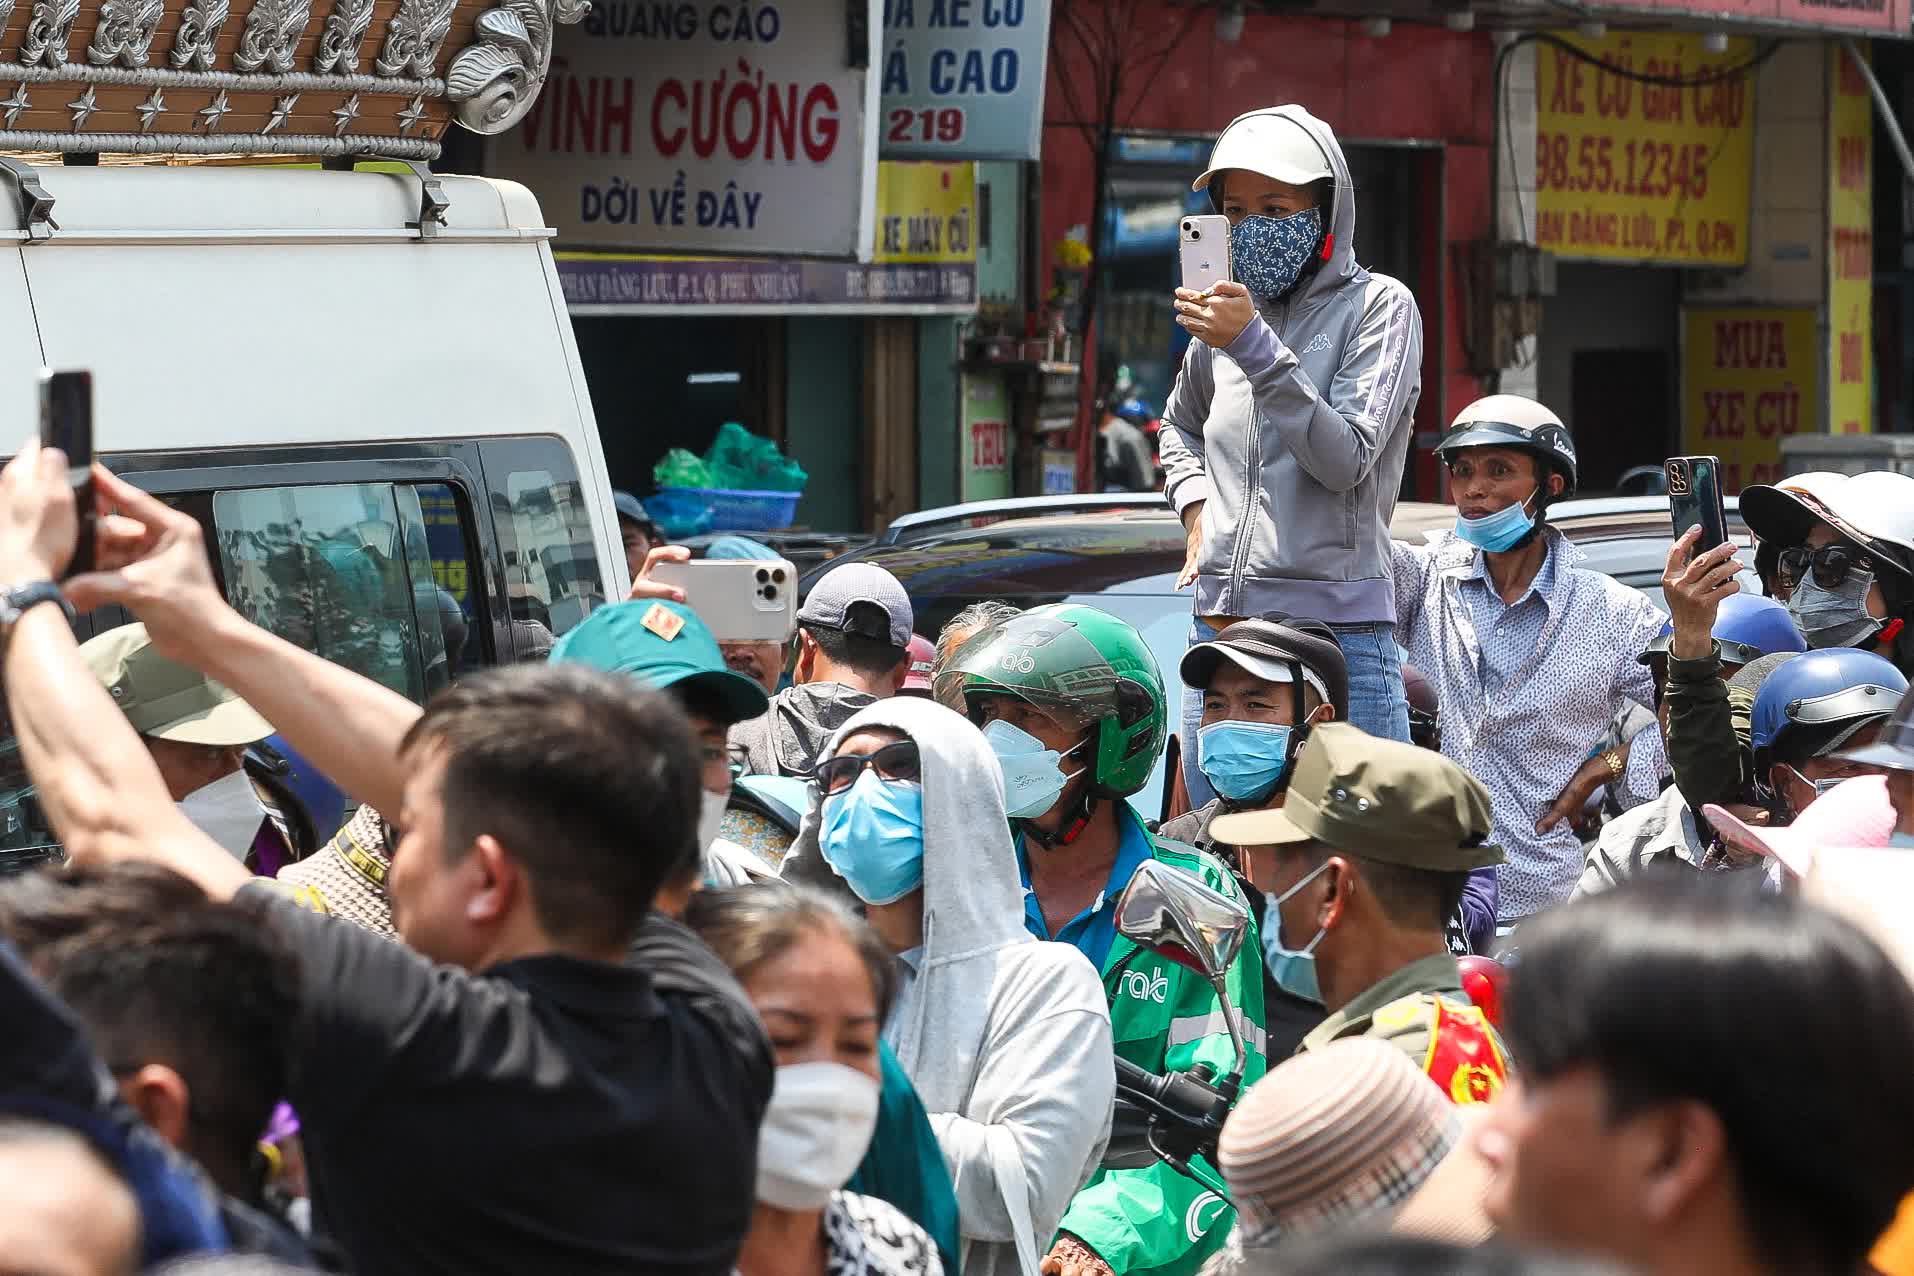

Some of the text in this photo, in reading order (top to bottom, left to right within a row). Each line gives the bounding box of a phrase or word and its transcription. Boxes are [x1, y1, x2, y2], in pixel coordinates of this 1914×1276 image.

[929, 47, 1019, 95] CAO
[521, 56, 840, 163] VĨNH CƯỜNG
[887, 107, 964, 143] 219
[581, 176, 639, 225] DỜI
[695, 180, 763, 230] ĐÂY
[1712, 320, 1788, 369] MUA
[1703, 391, 1746, 440] XE
